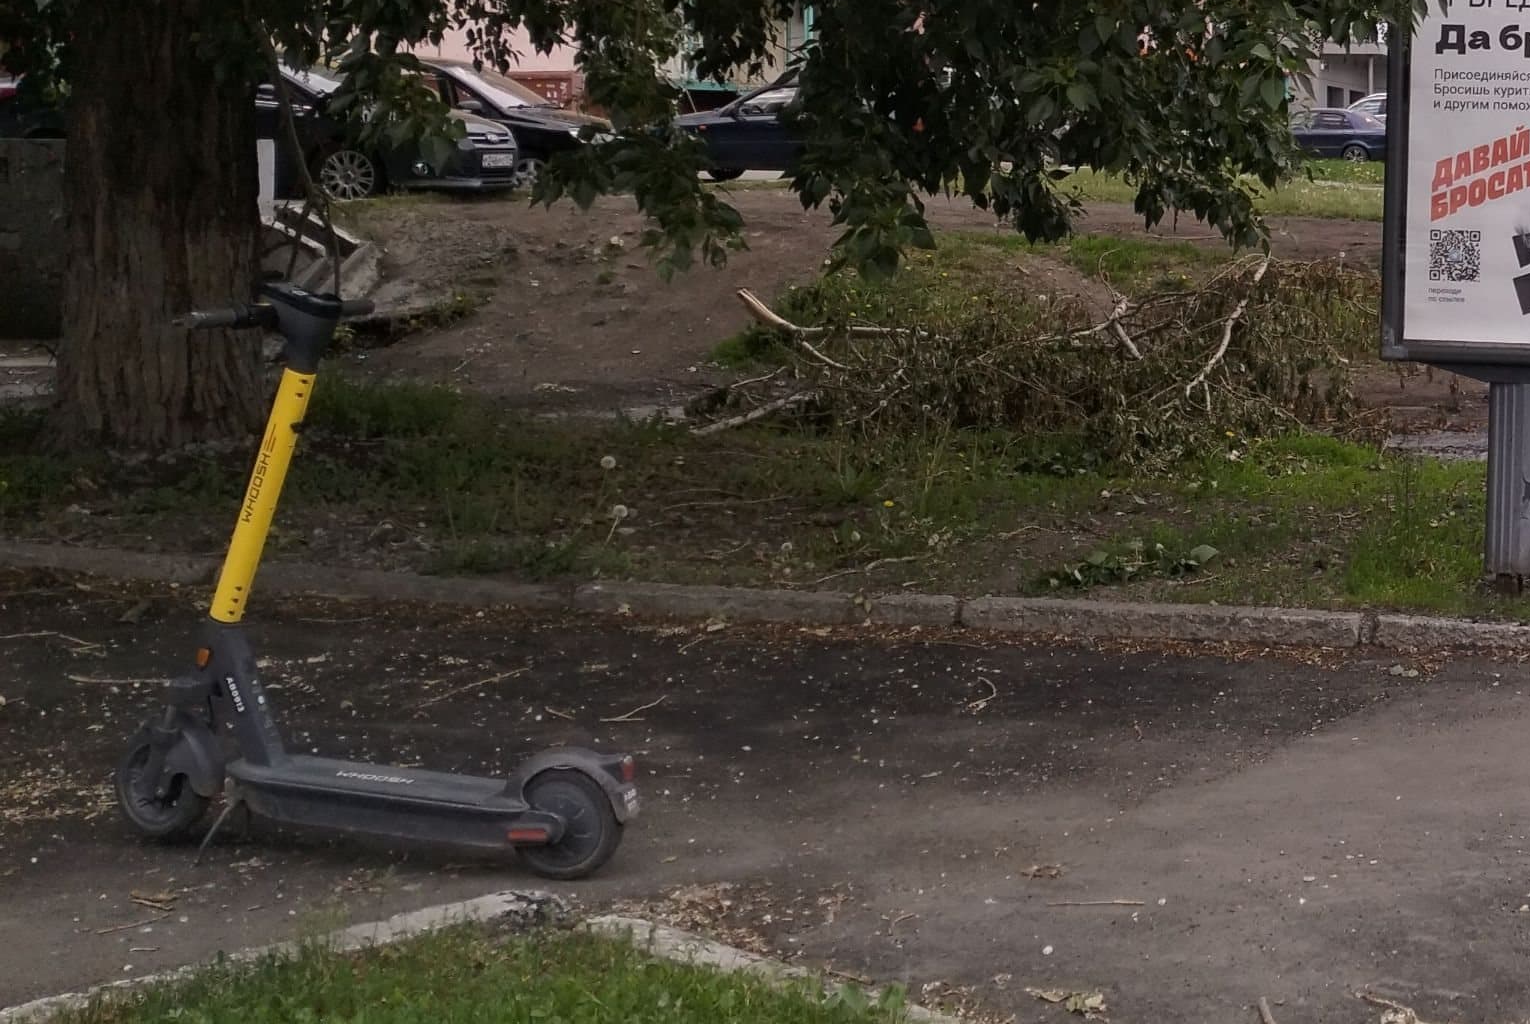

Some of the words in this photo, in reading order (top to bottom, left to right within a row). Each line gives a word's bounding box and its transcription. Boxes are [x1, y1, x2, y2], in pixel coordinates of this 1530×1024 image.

[1435, 23, 1491, 55] Да
[1433, 83, 1490, 97] Бросишь
[1433, 101, 1441, 109] и
[1444, 100, 1489, 112] другим
[1432, 125, 1530, 193] ДАВАЙ
[241, 451, 272, 524] WHOOSH
